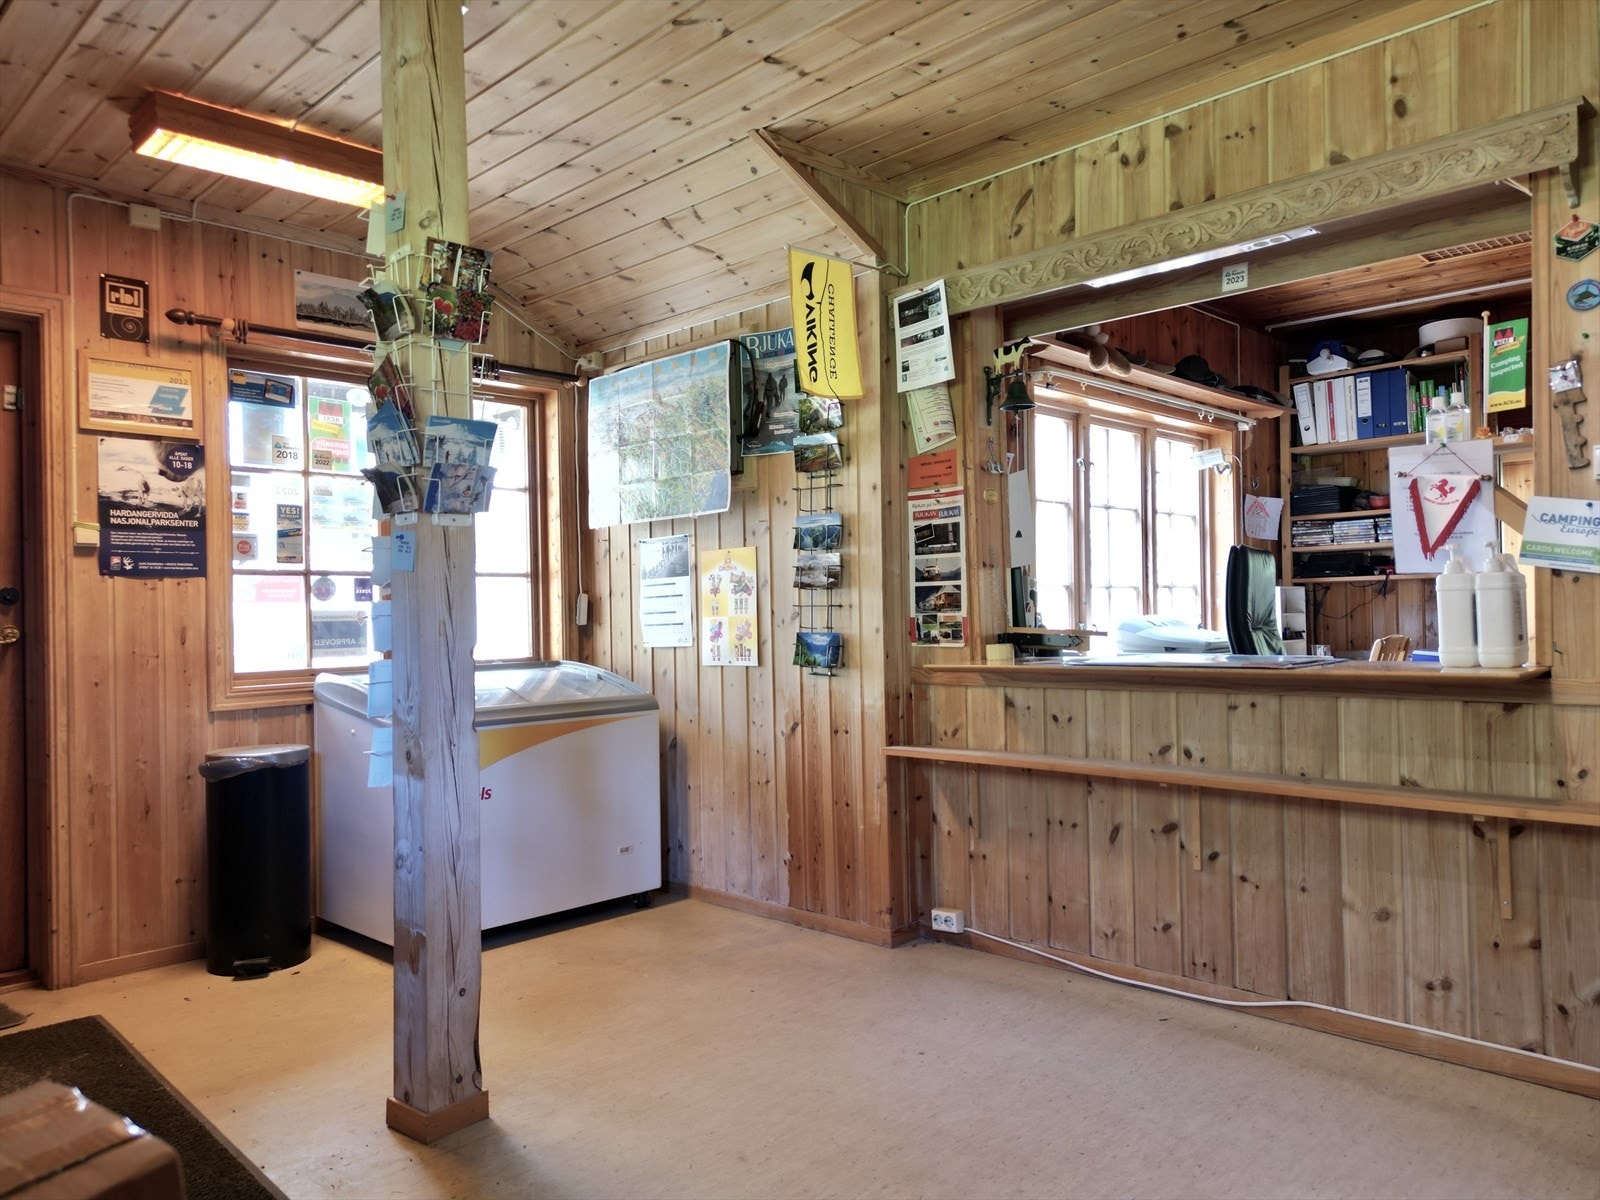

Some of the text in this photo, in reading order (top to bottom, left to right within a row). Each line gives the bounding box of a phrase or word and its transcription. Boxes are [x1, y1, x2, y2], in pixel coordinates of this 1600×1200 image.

[1226, 275, 1245, 285] 2023
[746, 330, 794, 360] RJUKA
[1490, 355, 1521, 369] Camping
[1490, 361, 1524, 378] Inspected
[169, 377, 188, 385] 2012
[276, 450, 299, 460] 2018
[172, 461, 193, 470] 10-18
[110, 509, 179, 519] HARDANGERVIDDA
[280, 506, 300, 515] YES!
[110, 517, 199, 528] NASJONALPARKSENTER
[1540, 512, 1600, 527] CAMPING
[1560, 523, 1600, 537] Europe
[1526, 543, 1594, 557] CARDS WELCOME
